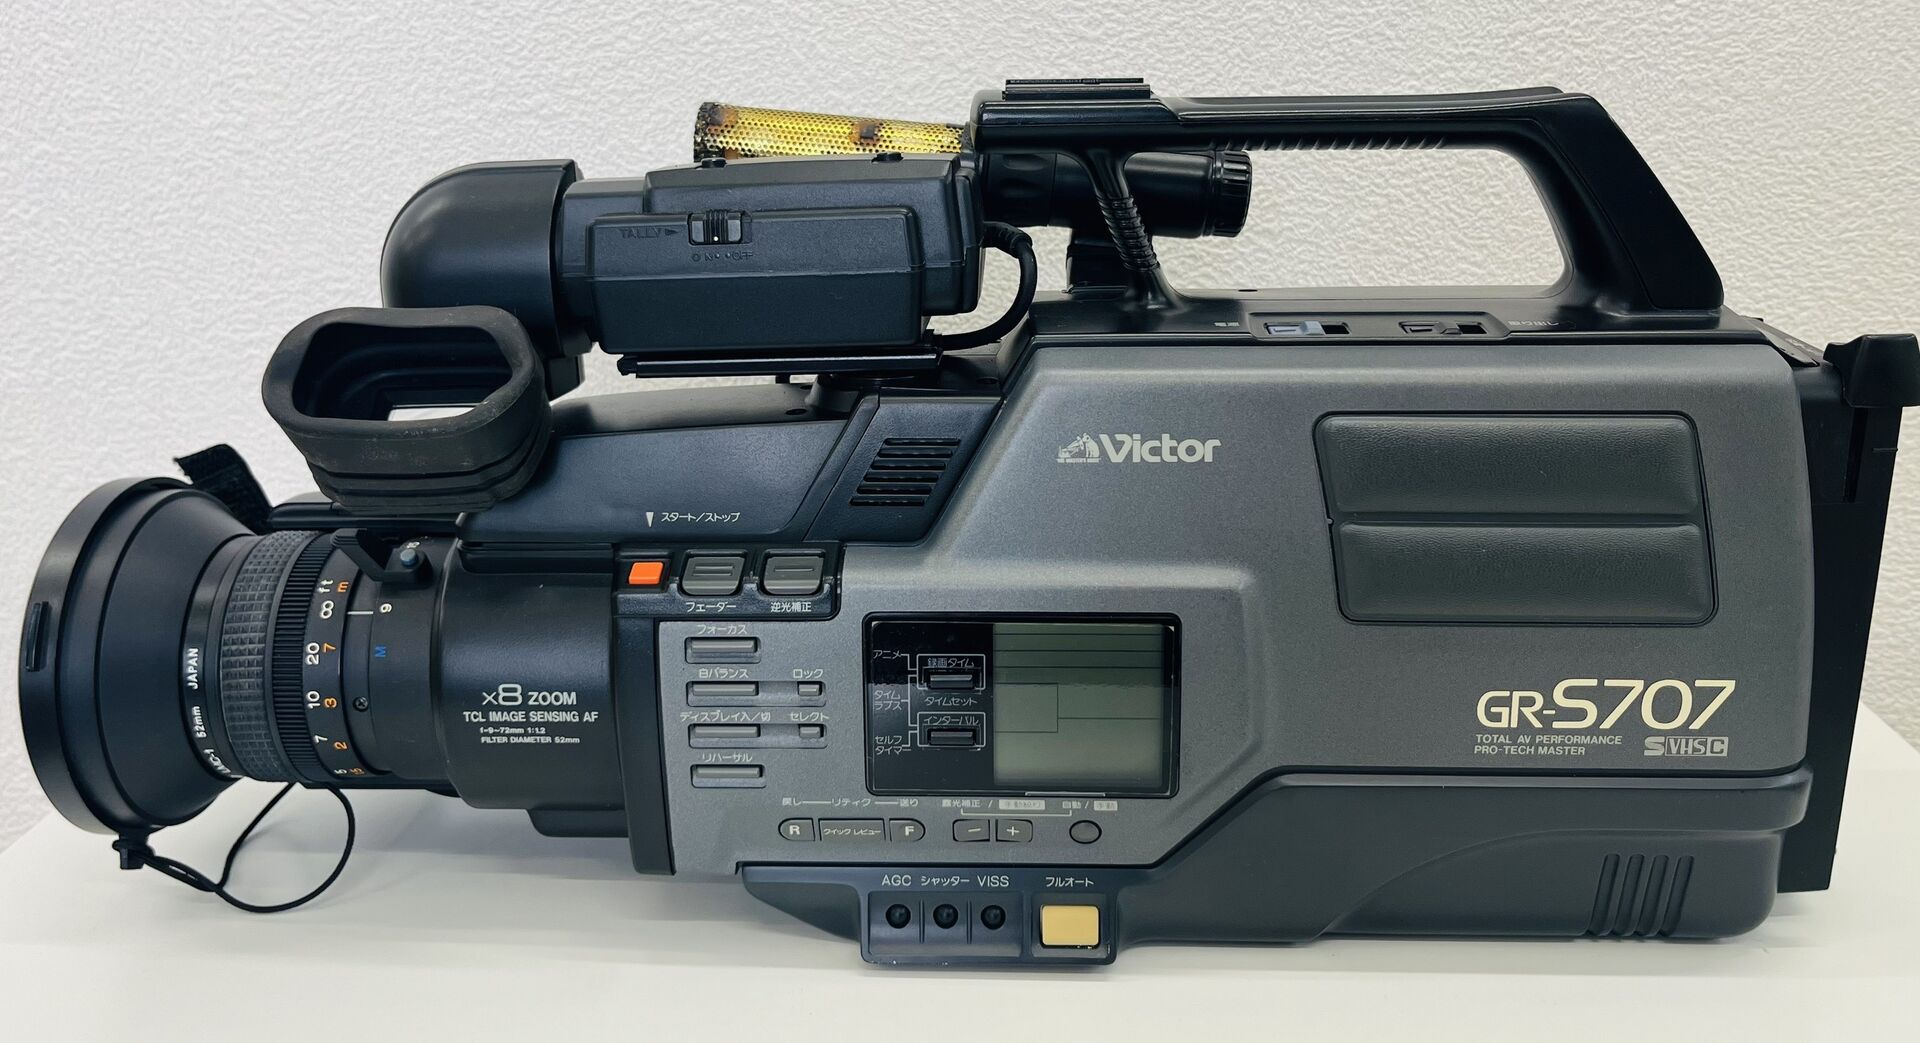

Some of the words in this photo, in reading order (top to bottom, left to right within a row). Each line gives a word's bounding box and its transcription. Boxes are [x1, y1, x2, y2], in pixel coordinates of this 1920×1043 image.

[619, 228, 662, 239] TALLY
[1100, 433, 1222, 463] Victor
[685, 602, 737, 613] フェーダー
[770, 602, 813, 613] 逆光補正
[697, 624, 748, 635] フォーカス
[322, 642, 337, 653] 7
[305, 642, 320, 666] 20
[873, 650, 902, 660] アニメ
[186, 648, 199, 690] JAPAN
[698, 667, 749, 679] 白バランス
[792, 668, 824, 678] ロック
[306, 690, 321, 709] 10
[527, 691, 577, 705] ZOOM
[874, 690, 901, 700] タイム
[323, 697, 338, 709] 3
[924, 696, 978, 707] タイムセット
[1476, 678, 1737, 730] GR-S707
[463, 711, 486, 722] TCL
[489, 711, 526, 723] IMAGE
[530, 711, 579, 723] SENSING
[583, 711, 599, 722] AF
[790, 712, 830, 721] セレクト
[923, 715, 980, 726] インターバル
[313, 734, 328, 744] 7
[875, 735, 902, 744] セルフ
[1475, 734, 1513, 744] TOTAL
[1517, 735, 1532, 744] AV
[1536, 735, 1623, 745] PERFORMANCE
[333, 740, 348, 750] 2
[875, 746, 911, 755] タイマー
[1474, 746, 1535, 756] PRO-TECH
[1538, 746, 1586, 756] MASTER
[702, 752, 753, 762] リハーサル
[789, 825, 800, 835] R
[905, 825, 915, 835] F
[881, 874, 912, 886] AGC
[920, 876, 970, 887] シャッター
[977, 875, 1010, 887] VISS
[1045, 876, 1094, 888] フルオート
